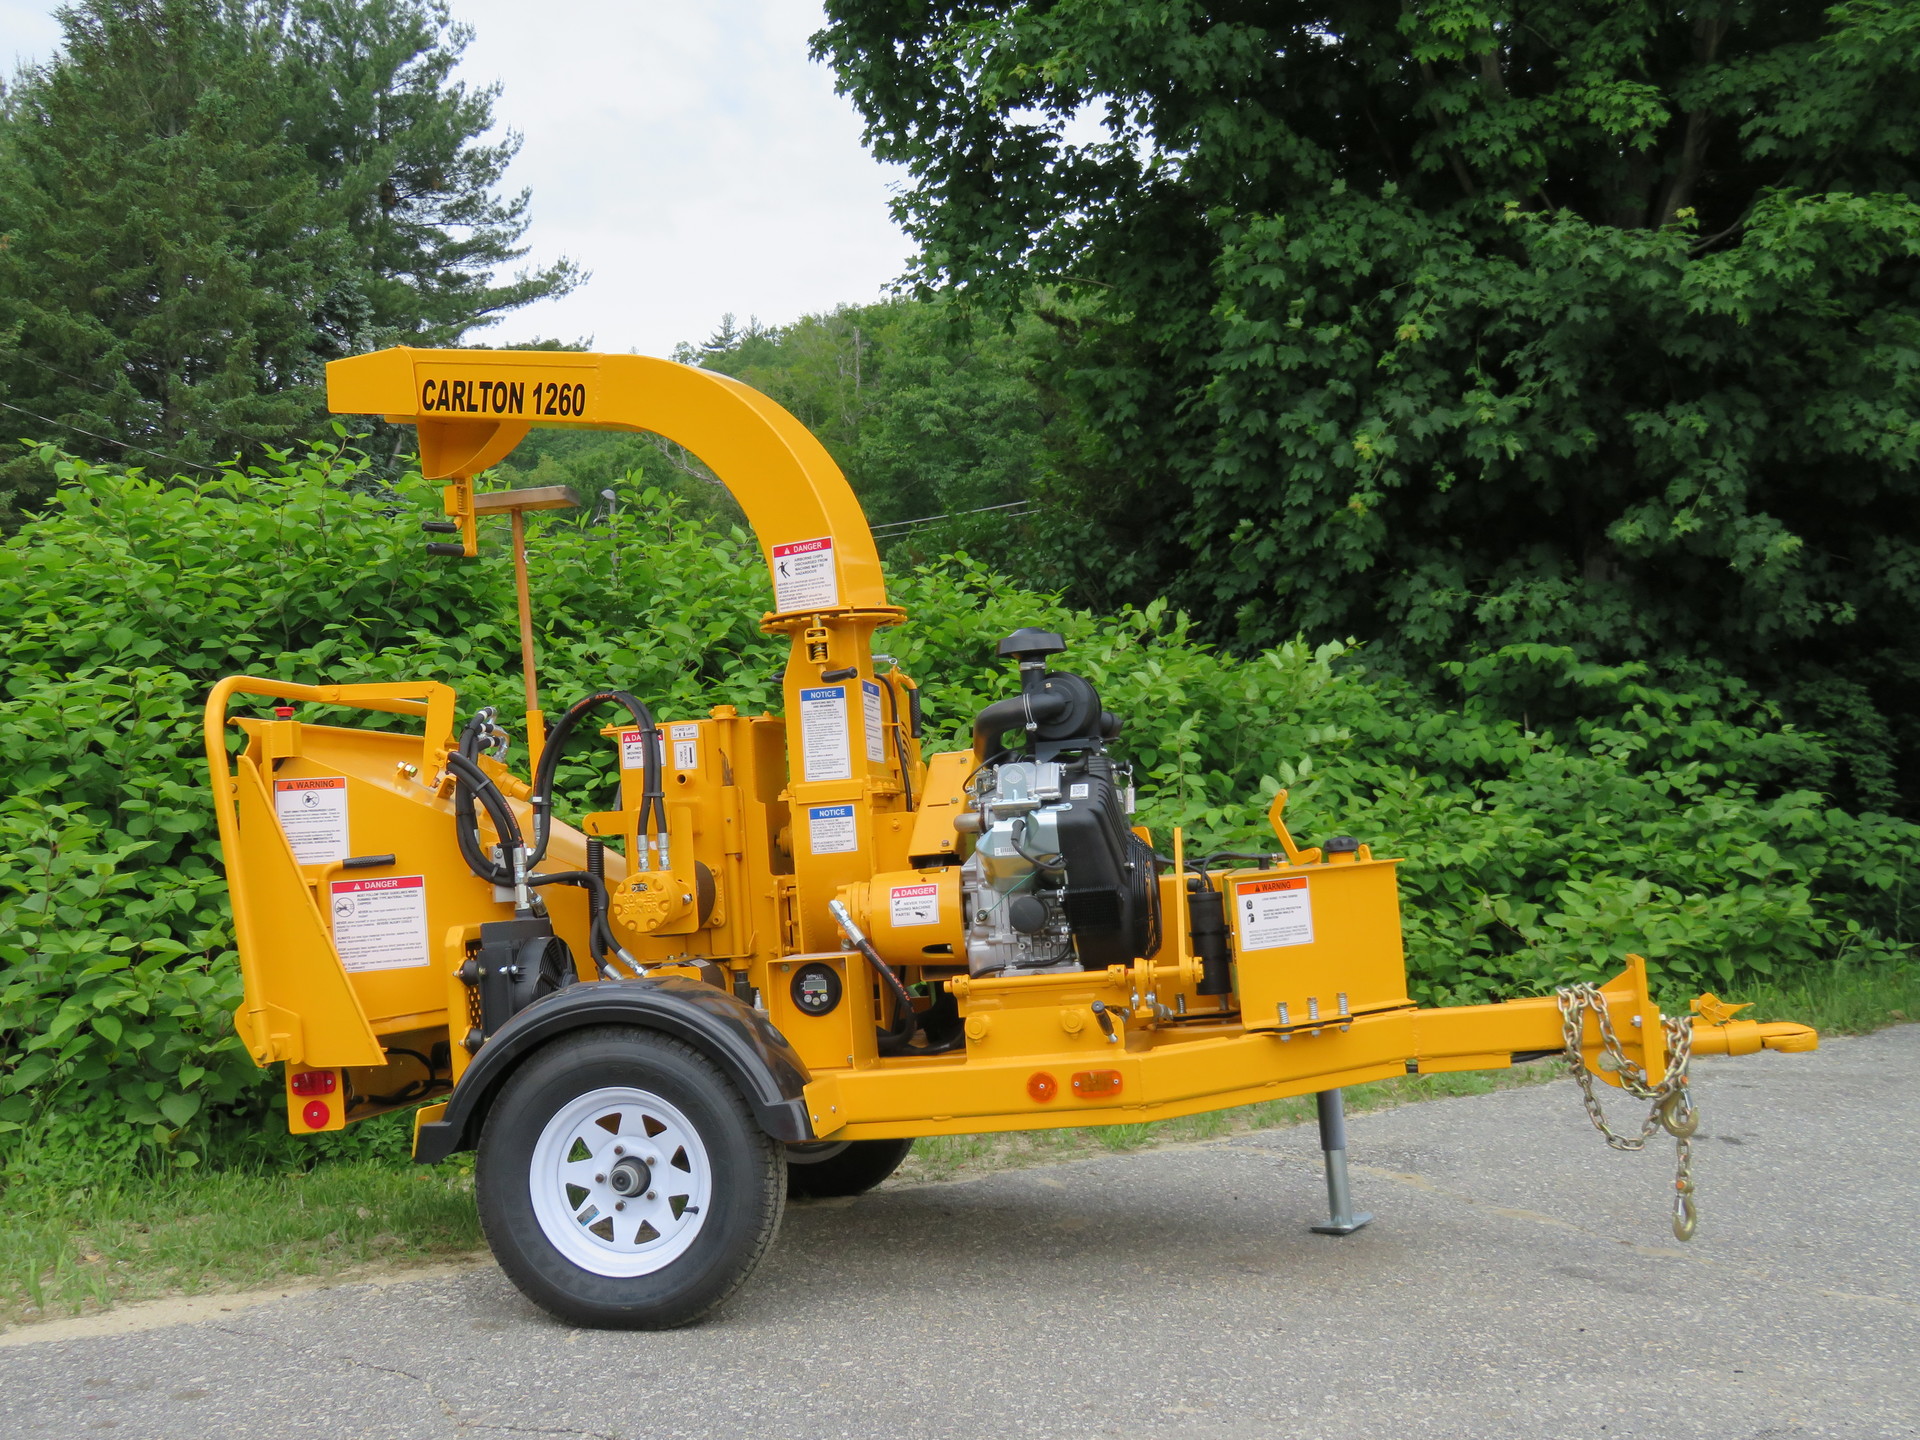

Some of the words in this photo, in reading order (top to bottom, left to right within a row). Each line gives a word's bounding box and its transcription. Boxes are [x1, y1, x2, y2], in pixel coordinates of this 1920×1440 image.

[422, 379, 525, 414] CARLTON
[532, 382, 586, 417] 1260
[793, 542, 822, 553] DANGER
[810, 690, 836, 698] NOTICE
[296, 780, 334, 789] WARNING
[364, 880, 398, 889] DANGER
[1262, 882, 1291, 891] WARNING
[901, 887, 935, 896] DANGER
